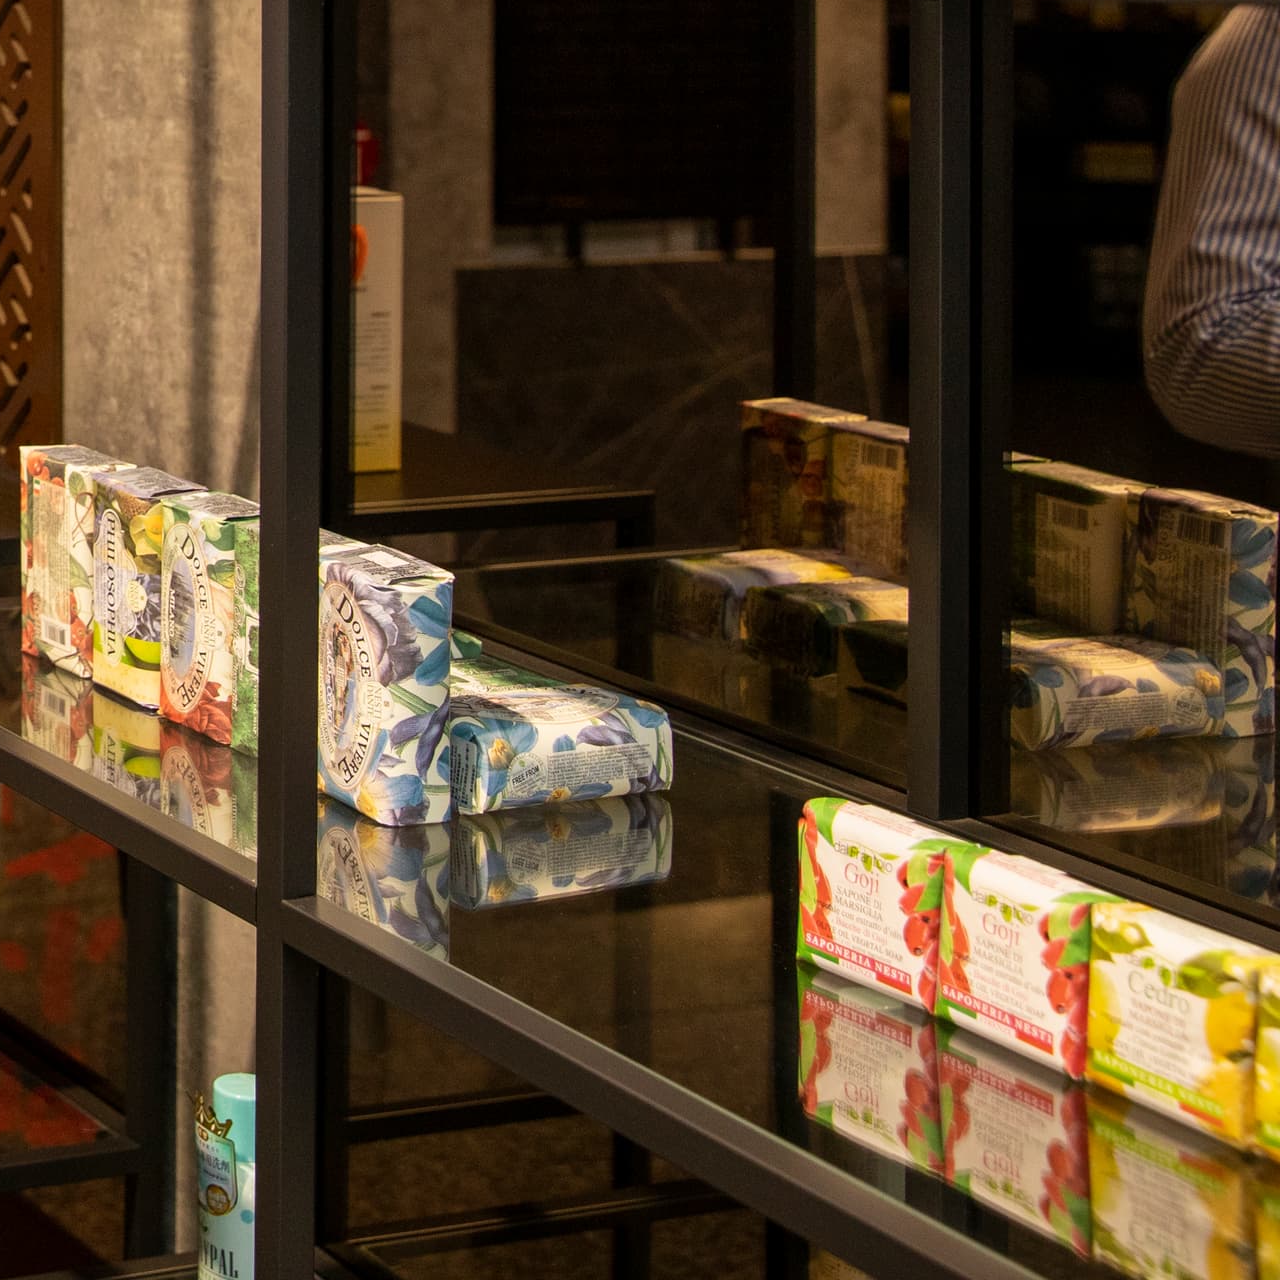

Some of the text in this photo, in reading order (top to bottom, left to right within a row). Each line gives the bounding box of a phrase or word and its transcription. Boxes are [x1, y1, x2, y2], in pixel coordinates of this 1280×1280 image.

[106, 517, 117, 657] PHILOSOPHIA
[176, 533, 208, 708] DOLCE VIVERE
[335, 593, 372, 784] DOLCE VIVERE
[511, 765, 540, 787] FREE FROM
[836, 885, 872, 907] SAPONE
[844, 862, 880, 895] Goji
[834, 895, 884, 922] MARSIGLIA
[982, 913, 1021, 946] Goji
[805, 932, 911, 986] SAPONERIA NESTI
[1127, 970, 1191, 1013] Cedro
[941, 984, 1053, 1045] SAPONERIA NESTI
[1094, 1049, 1175, 1095] SAPONERIA
